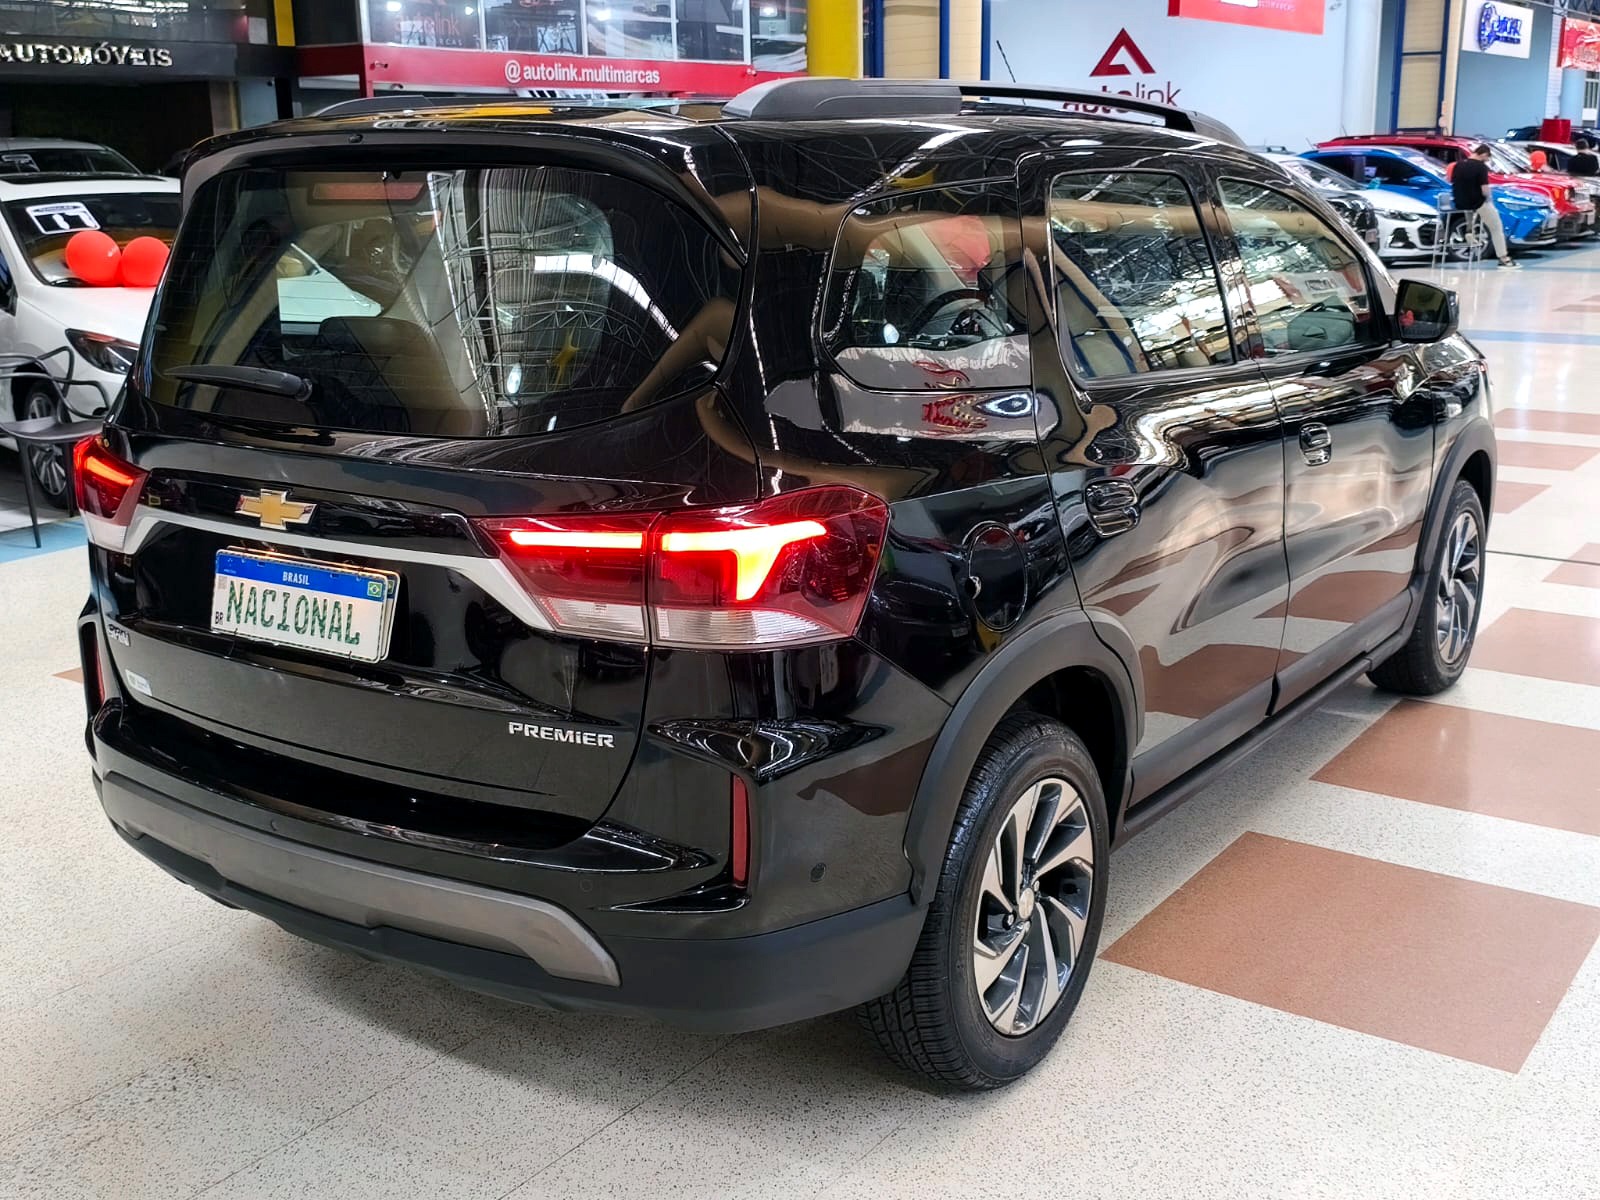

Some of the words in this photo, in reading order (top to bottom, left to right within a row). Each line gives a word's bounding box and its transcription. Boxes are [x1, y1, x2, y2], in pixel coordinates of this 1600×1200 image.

[0, 42, 173, 67] AUTOMÓVEIS
[282, 571, 310, 585] BRASIL
[214, 611, 224, 625] BR
[226, 580, 361, 645] NACIONAL
[508, 721, 615, 748] PREMIER
